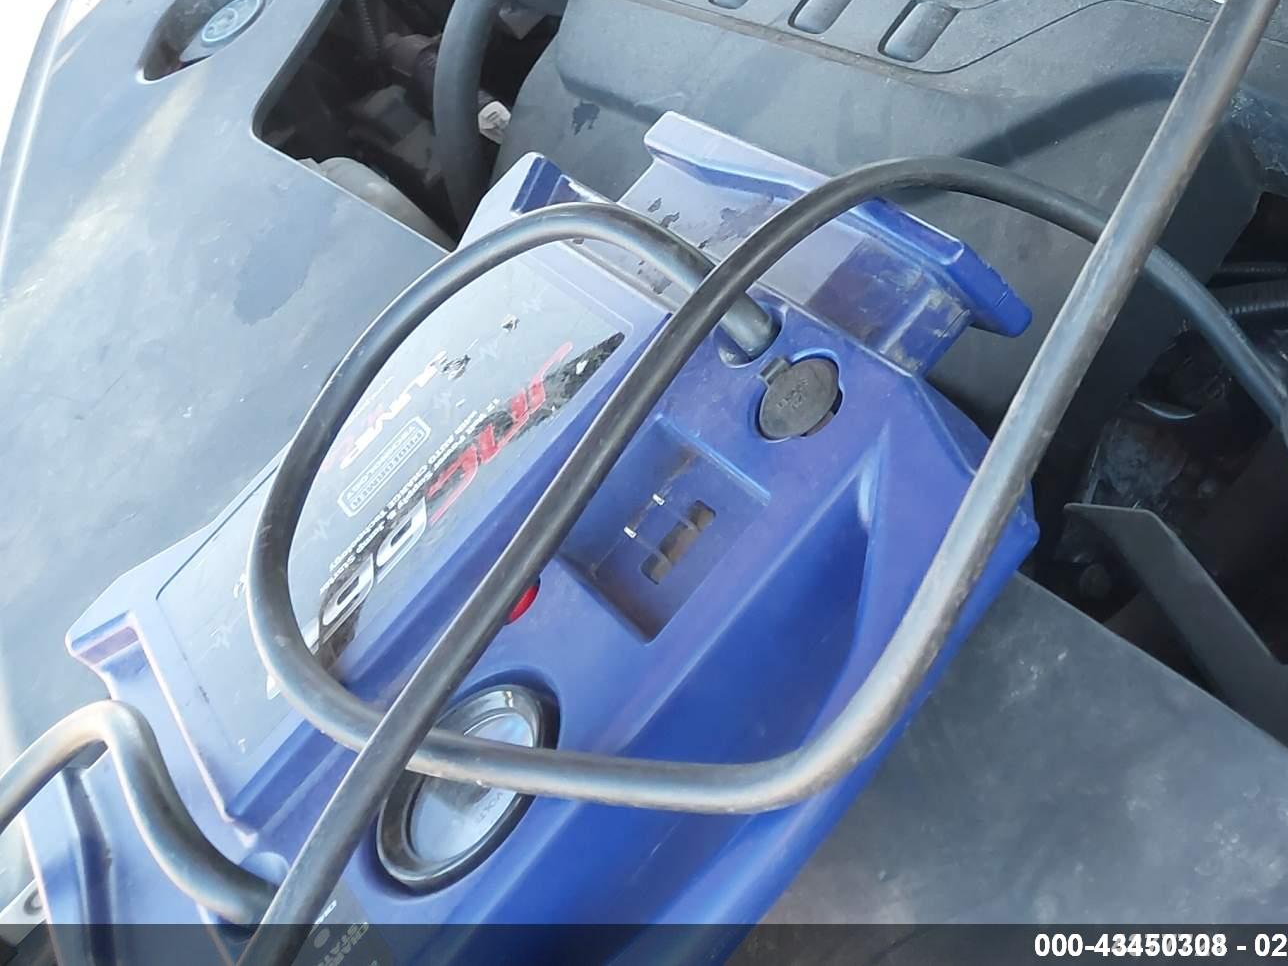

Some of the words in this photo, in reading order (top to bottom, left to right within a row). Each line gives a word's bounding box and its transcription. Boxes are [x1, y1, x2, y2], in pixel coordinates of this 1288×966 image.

[426, 434, 454, 464] AUTO
[430, 434, 466, 470] Power
[394, 470, 432, 510] Supply
[352, 520, 386, 554] Jump
